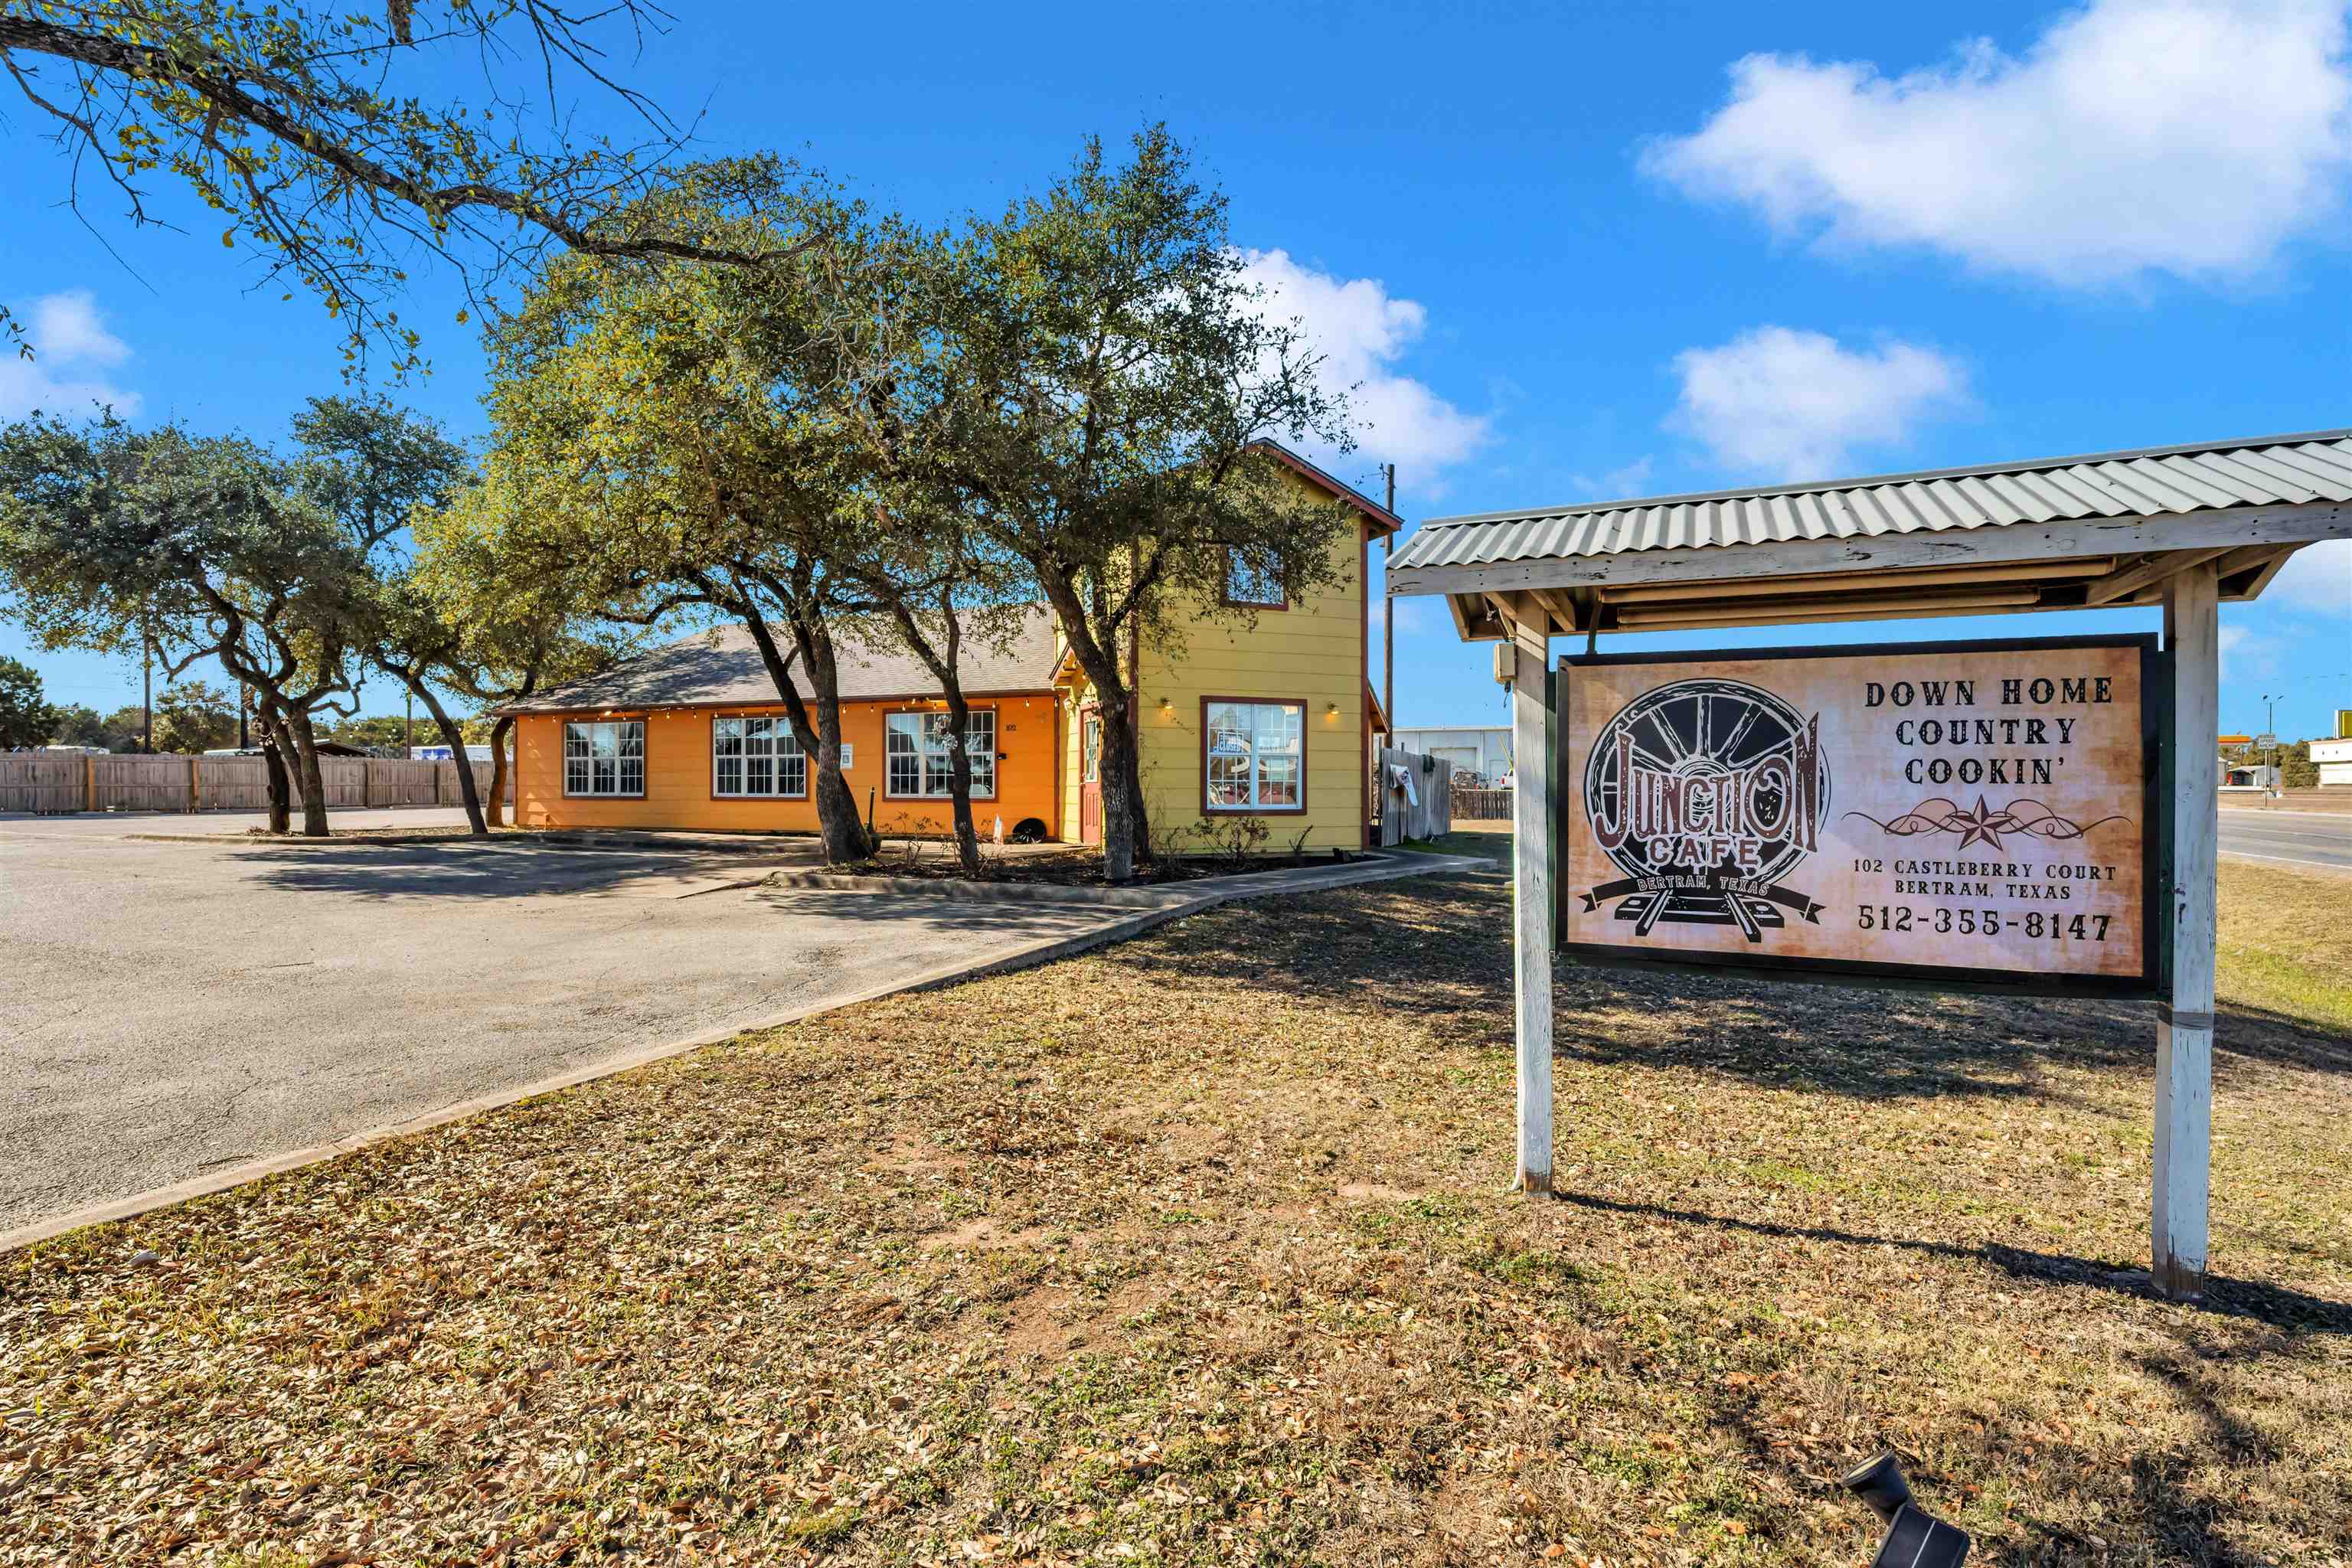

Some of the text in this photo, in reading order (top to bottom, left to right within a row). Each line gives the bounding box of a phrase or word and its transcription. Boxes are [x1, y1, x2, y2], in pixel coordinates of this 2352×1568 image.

[1865, 677, 2113, 707] DOWN HOME
[1896, 717, 2076, 746] COUNTRY
[1595, 711, 1818, 853] JUNCTION
[1905, 757, 2065, 785] COOKIN'
[1650, 839, 1760, 866] CAFE
[1854, 859, 2117, 881] 102 CASTLEBERRY COURT
[1636, 874, 1771, 896] BERTRAM, TEXAS
[1895, 880, 2072, 900] BERTRAM, TEXAS
[1858, 905, 2112, 942] 512-355-8147
